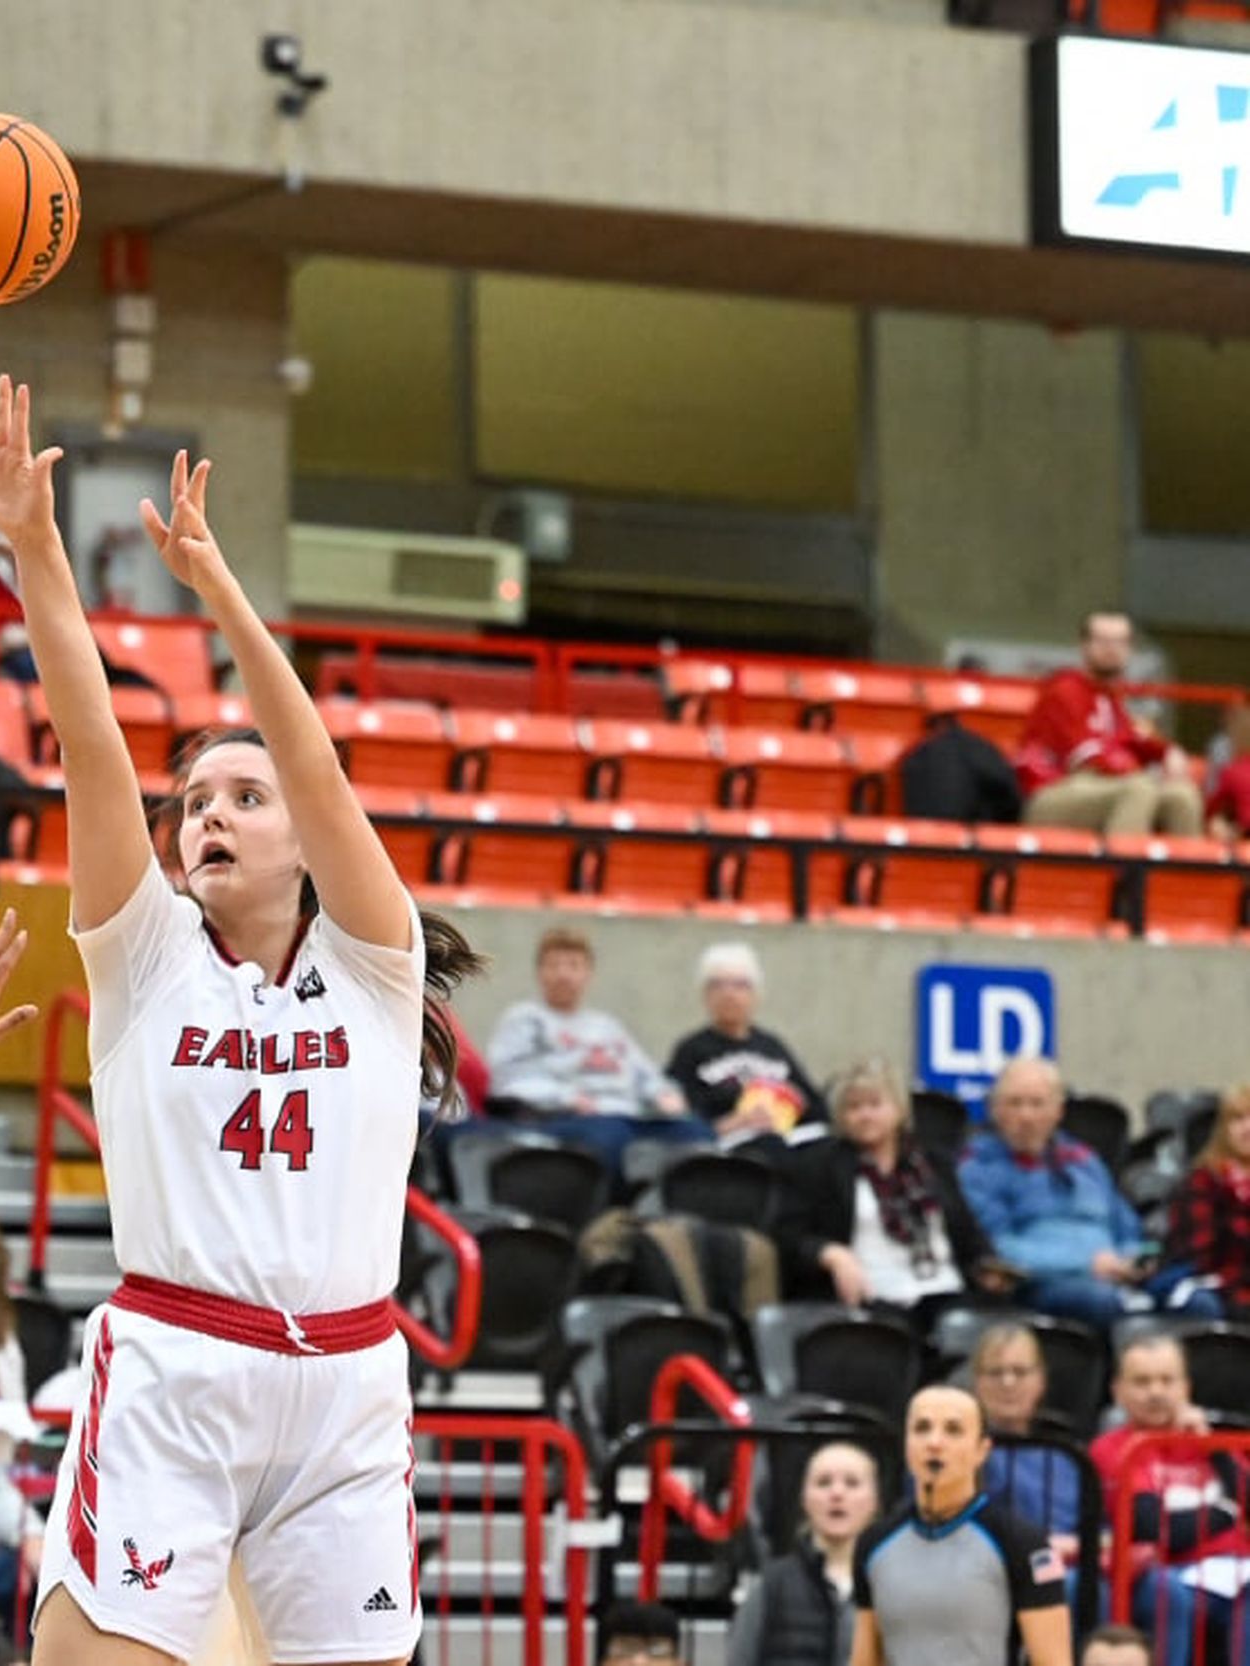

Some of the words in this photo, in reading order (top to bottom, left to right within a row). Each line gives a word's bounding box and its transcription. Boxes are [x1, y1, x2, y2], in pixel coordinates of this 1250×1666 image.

[4, 193, 64, 298] Wilson
[929, 982, 1044, 1076] LD
[219, 1088, 314, 1171] 44
